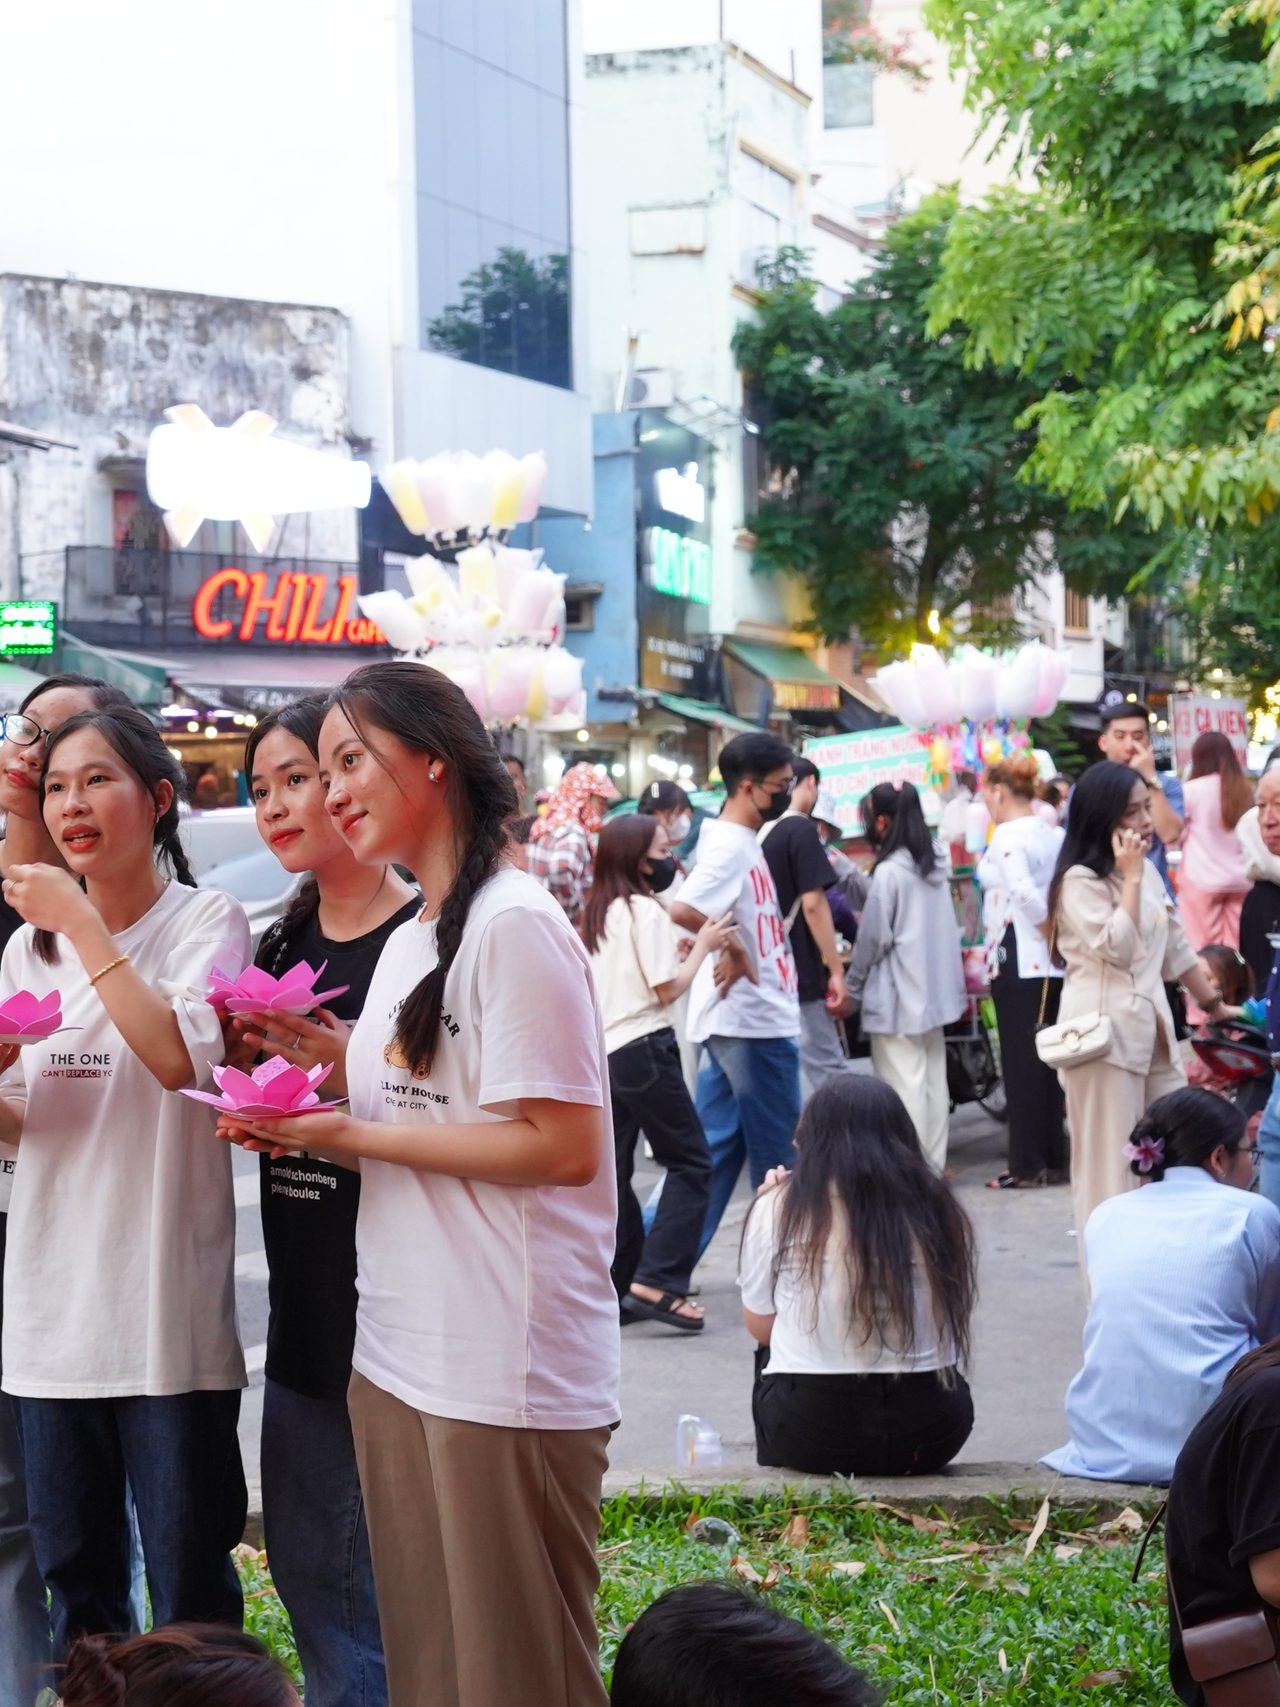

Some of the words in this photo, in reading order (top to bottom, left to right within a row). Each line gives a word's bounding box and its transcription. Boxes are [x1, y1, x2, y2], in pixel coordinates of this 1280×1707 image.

[194, 568, 358, 643] CHILI
[50, 1054, 75, 1065] THE
[80, 1054, 110, 1065] ONE
[392, 1085, 409, 1094] MY
[411, 1087, 450, 1105] HOUSE
[409, 1102, 428, 1110] CITY
[288, 1185, 321, 1200] boulez
